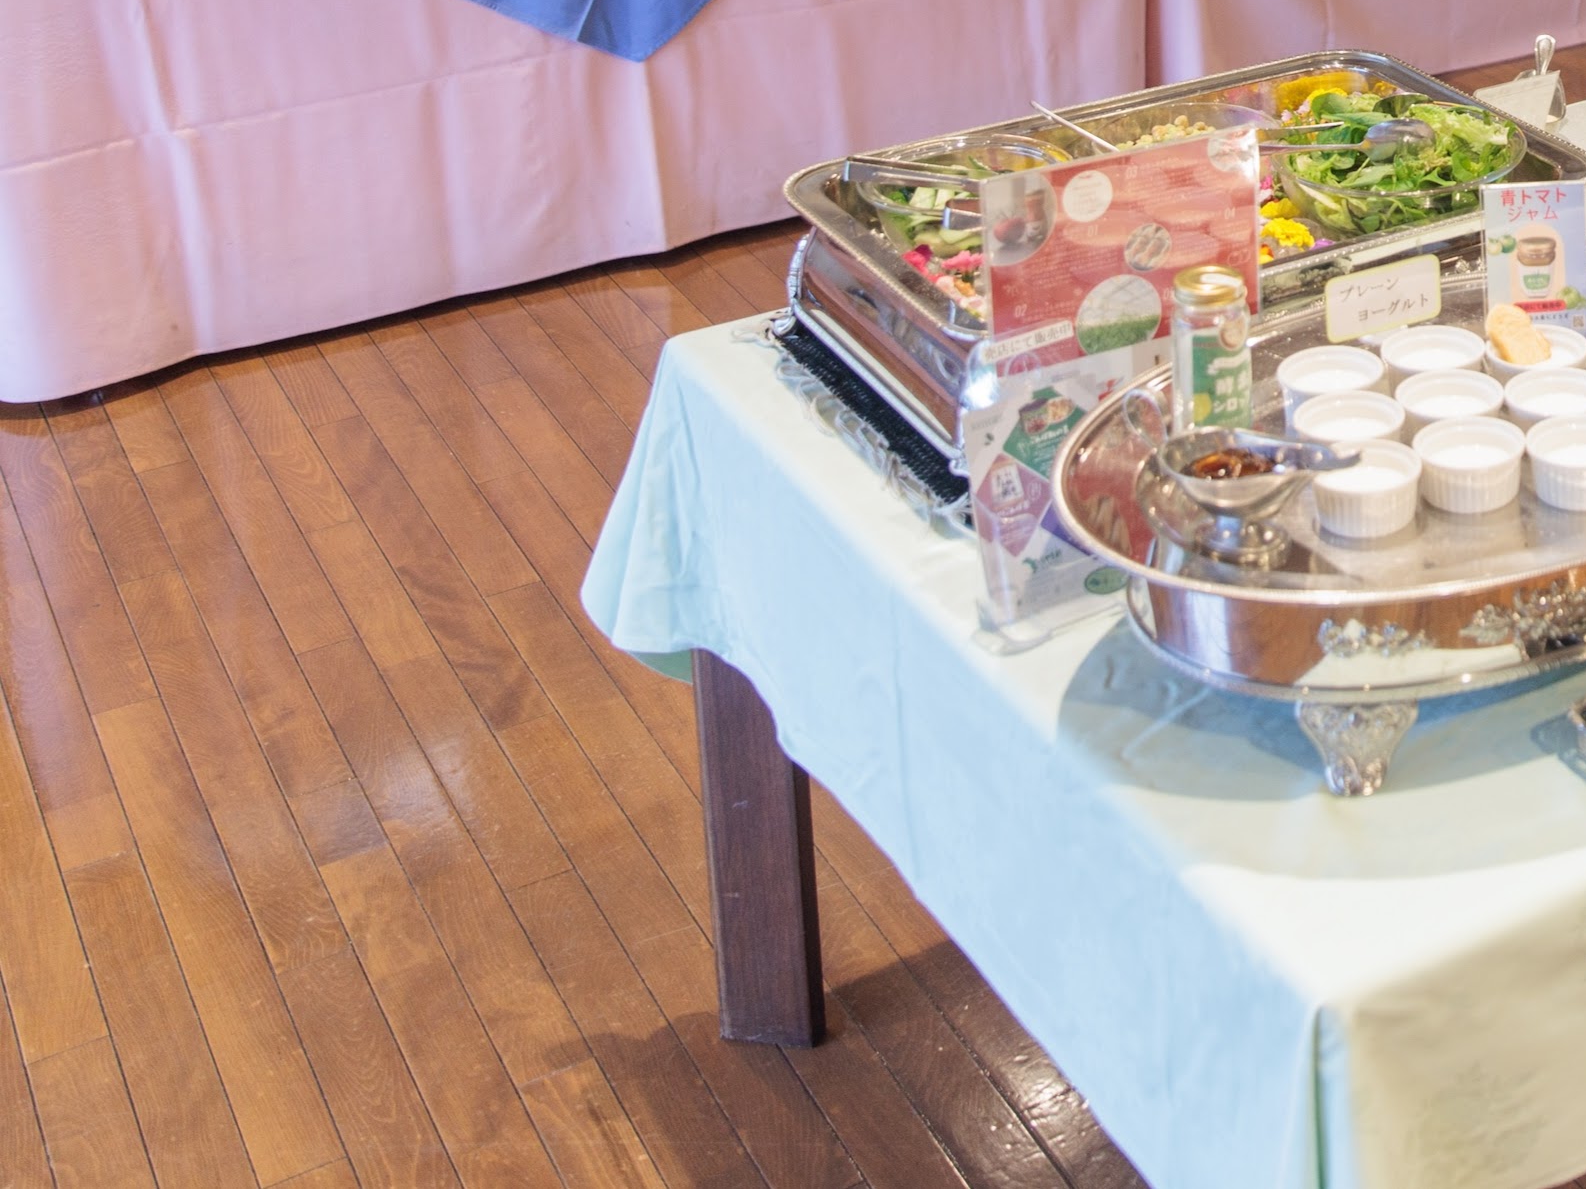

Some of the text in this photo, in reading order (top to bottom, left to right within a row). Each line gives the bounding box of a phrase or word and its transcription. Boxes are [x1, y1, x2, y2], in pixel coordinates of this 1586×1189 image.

[1500, 187, 1567, 207] 青トマト
[1507, 205, 1559, 223] ジャム
[1358, 293, 1429, 322] ヨーグルト
[984, 322, 1073, 360] 売店にて販売中
